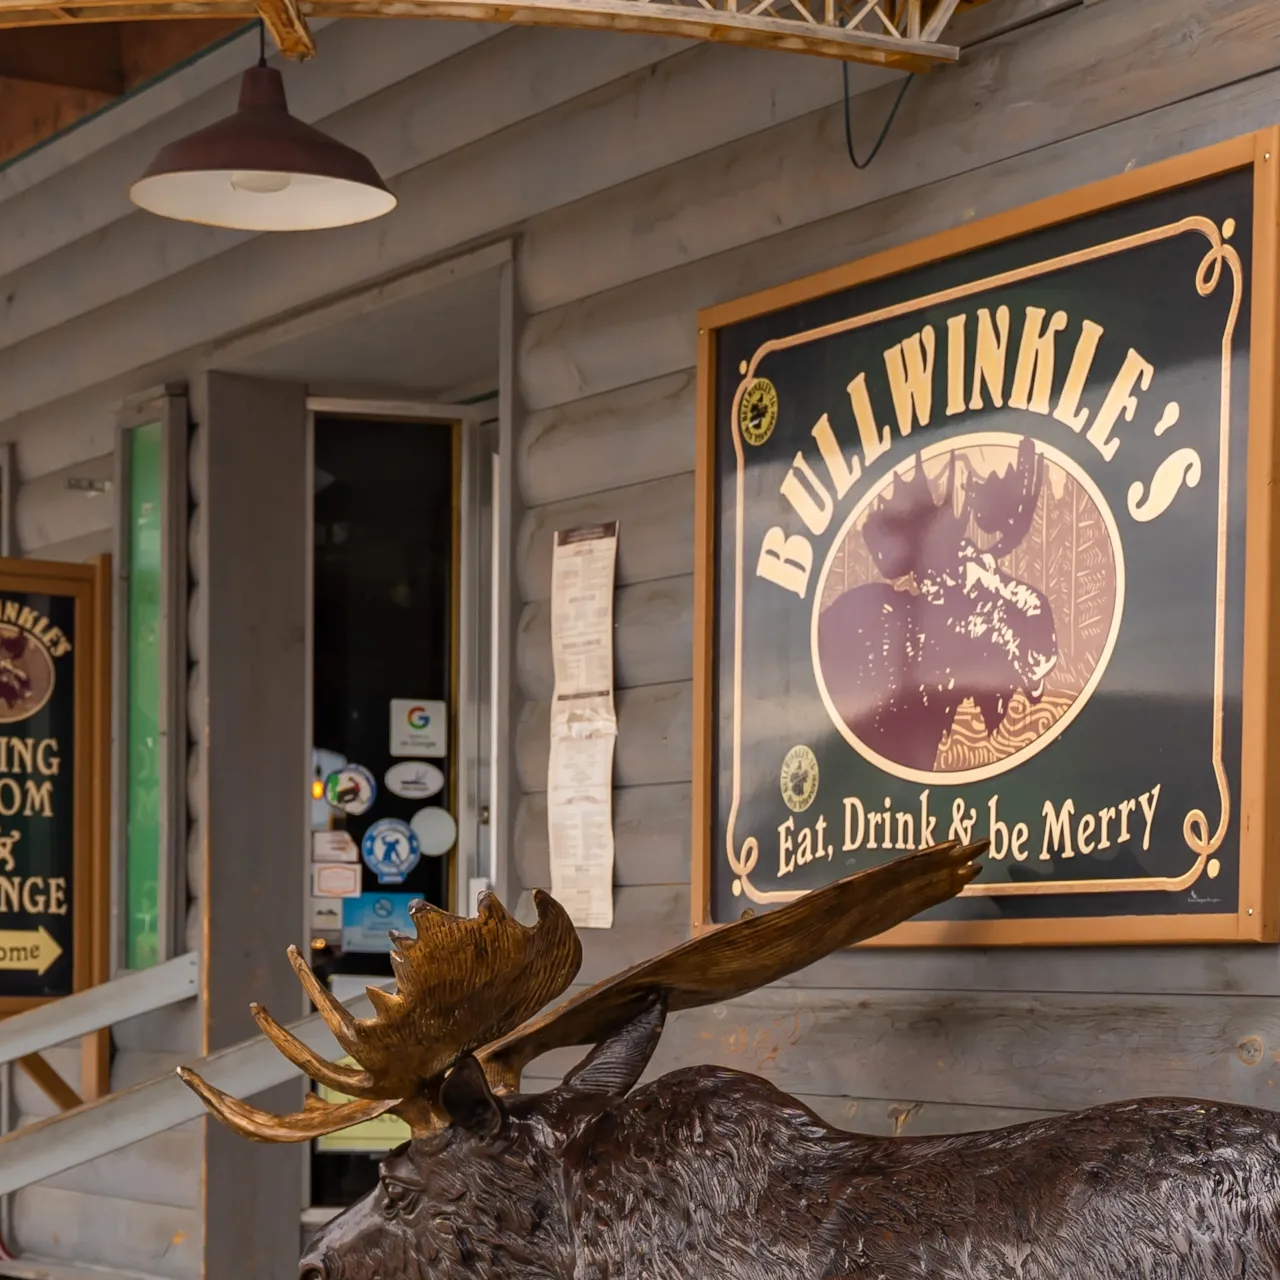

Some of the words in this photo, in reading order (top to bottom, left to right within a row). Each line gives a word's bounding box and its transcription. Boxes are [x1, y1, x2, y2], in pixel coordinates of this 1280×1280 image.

[756, 305, 1201, 599] BULLWINKLE'S
[777, 813, 833, 878] Eat,
[842, 789, 937, 852] Drink
[948, 797, 977, 850] &
[988, 794, 1029, 861] be
[1039, 784, 1161, 861] Merry
